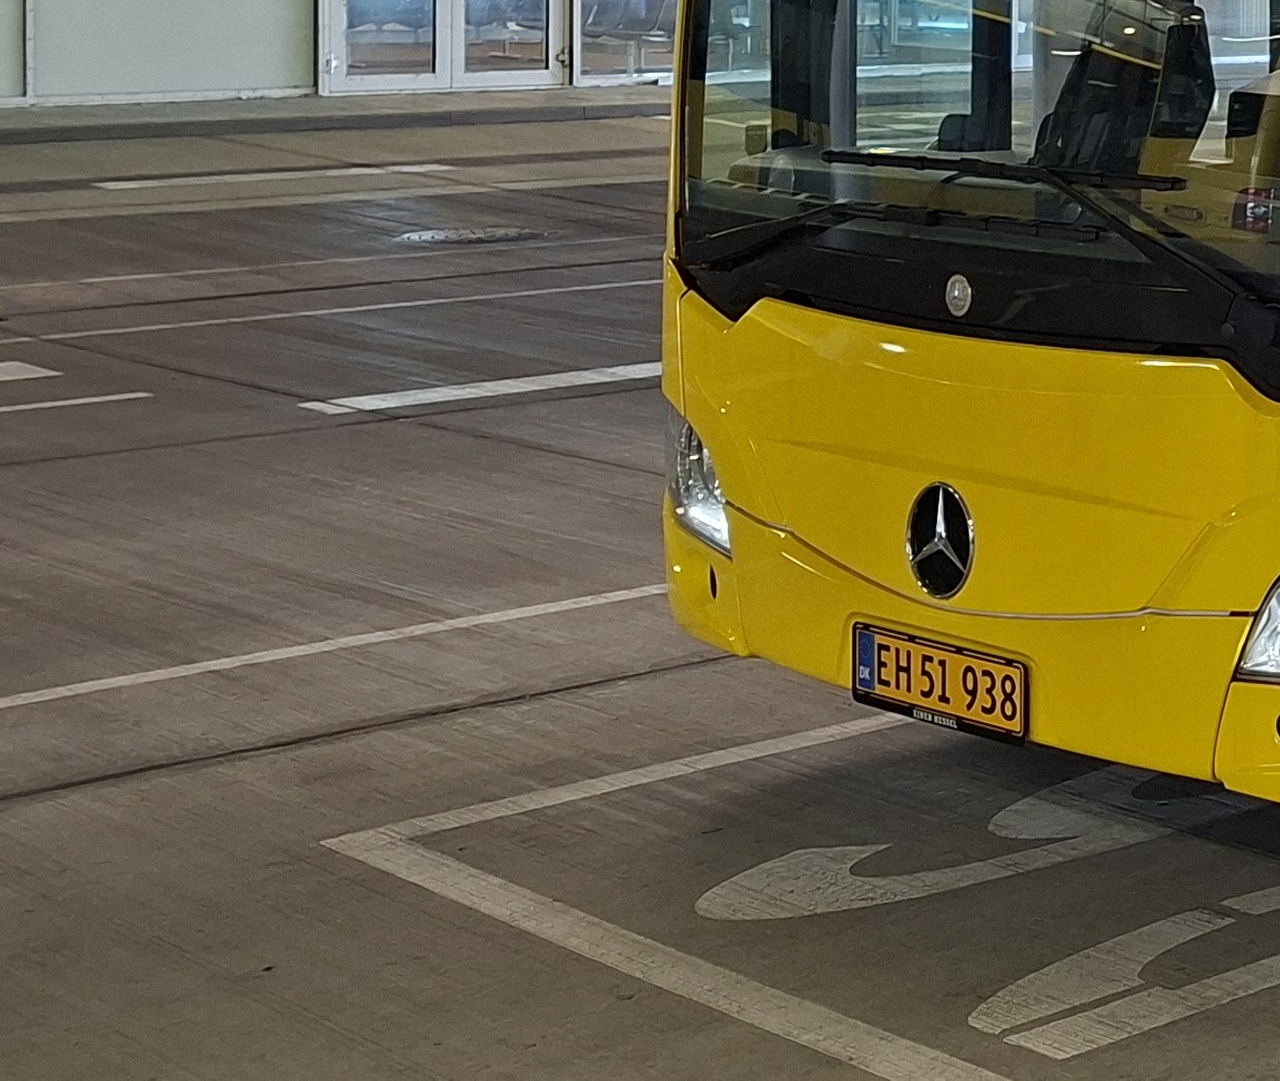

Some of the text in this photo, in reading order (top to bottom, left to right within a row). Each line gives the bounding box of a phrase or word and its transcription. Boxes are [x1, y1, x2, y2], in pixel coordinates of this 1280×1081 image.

[859, 665, 871, 681] DK
[877, 642, 1018, 722] EH 51 938
